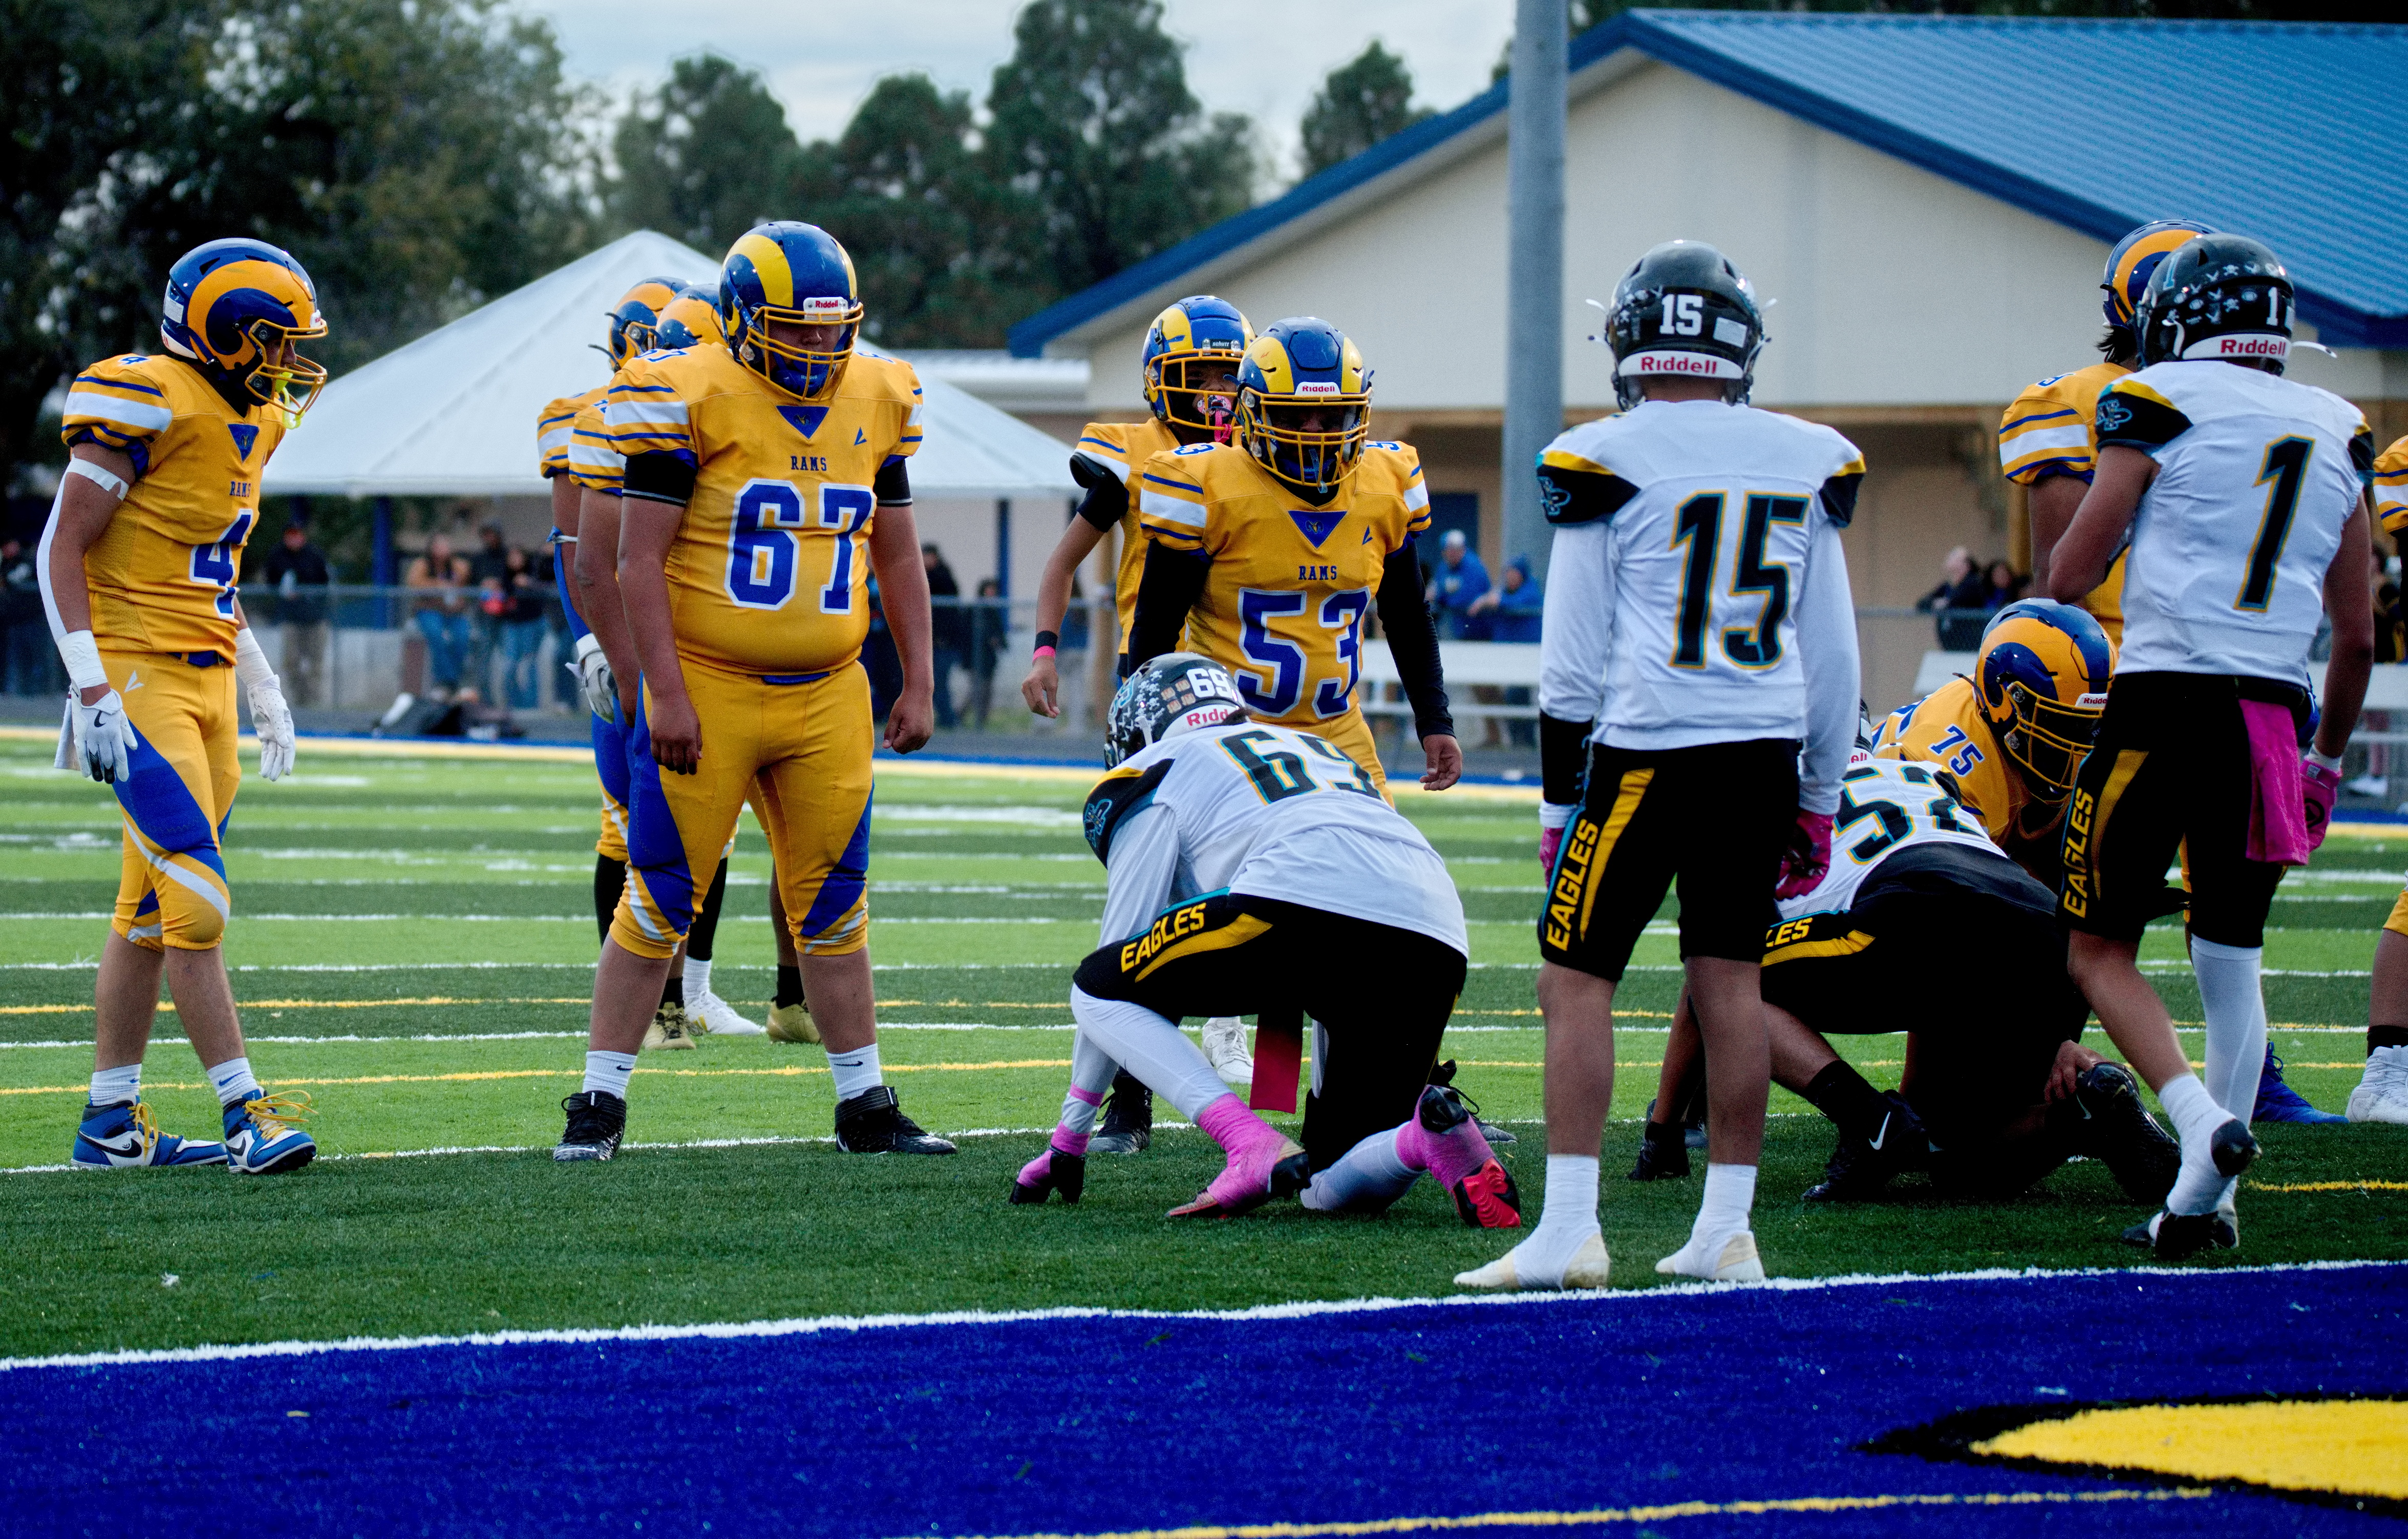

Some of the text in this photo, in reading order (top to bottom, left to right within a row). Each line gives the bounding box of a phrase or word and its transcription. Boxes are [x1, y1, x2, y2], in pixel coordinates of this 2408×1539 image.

[1659, 293, 1703, 336] 15
[2267, 287, 2278, 326] 1
[1641, 356, 1717, 374] Riddell
[2221, 339, 2286, 355] Riddell
[791, 455, 827, 471] RAMS
[724, 477, 878, 615] 67
[2233, 433, 2316, 613] 1
[189, 508, 253, 619] 4
[1298, 565, 1338, 580] RAMS
[1668, 490, 1812, 670] 15
[1186, 668, 1233, 698] 69
[1233, 585, 1371, 719] 53
[1214, 728, 1386, 806] 69
[1928, 723, 1985, 777] 75
[1831, 765, 1985, 866] 52
[2063, 787, 2094, 918] EAGLES
[1546, 818, 1599, 952] EAGLES
[1120, 902, 1207, 973] EAGLES
